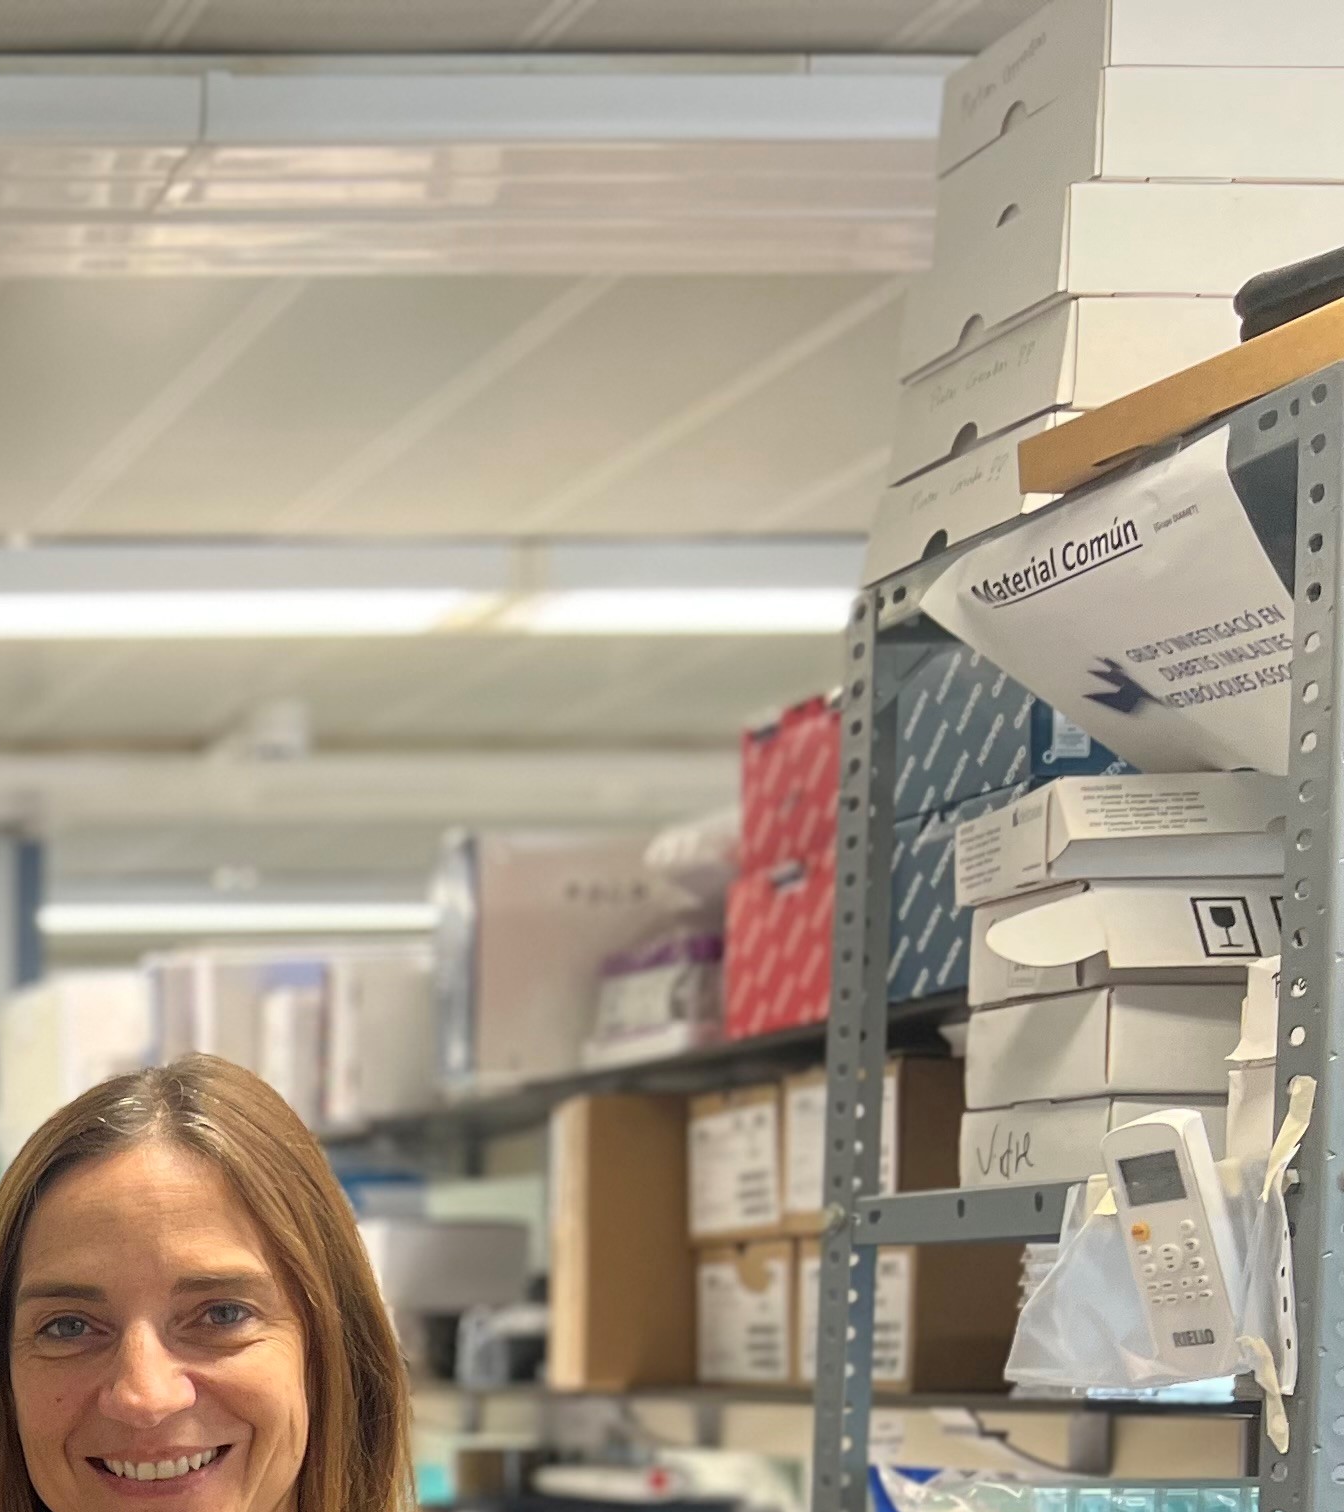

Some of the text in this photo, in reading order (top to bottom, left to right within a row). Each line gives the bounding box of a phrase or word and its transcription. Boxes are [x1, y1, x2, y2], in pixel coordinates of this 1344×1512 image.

[970, 516, 1140, 605] Material Común
[1257, 604, 1286, 625] EN
[1173, 1329, 1215, 1348] RIELLO
